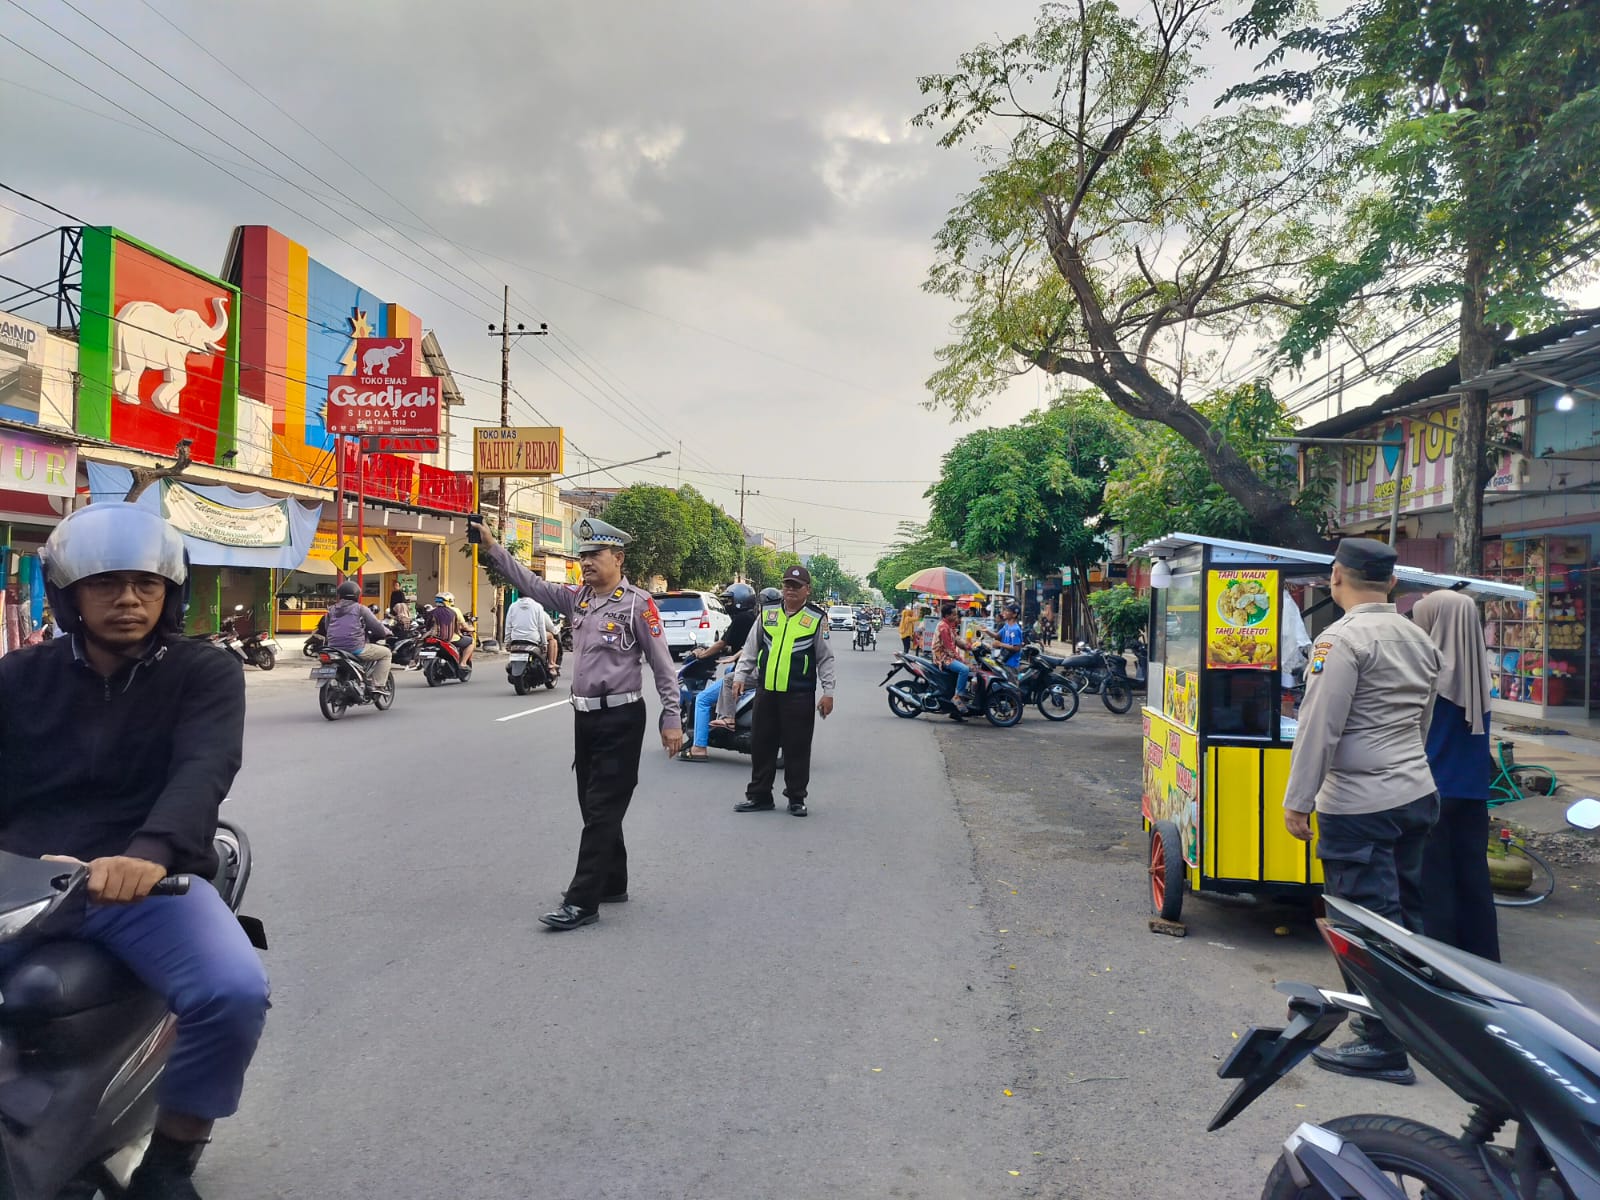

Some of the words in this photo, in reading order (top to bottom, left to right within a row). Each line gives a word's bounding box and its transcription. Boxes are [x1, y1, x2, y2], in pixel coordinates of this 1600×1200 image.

[0, 321, 37, 344] AND
[361, 377, 383, 385] TOKO
[384, 377, 407, 385] EMAS
[330, 385, 436, 410] Gadjah
[348, 410, 417, 418] SIDOARJO
[479, 430, 499, 439] TOKO
[501, 430, 517, 439] MAS
[1343, 437, 1377, 487] TIP
[1409, 407, 1461, 468] TOP
[479, 441, 514, 470] WAHYU
[525, 441, 558, 470] REDJO
[0, 444, 69, 487] UR
[1218, 571, 1238, 579] TAHU
[1215, 627, 1235, 635] TAHU
